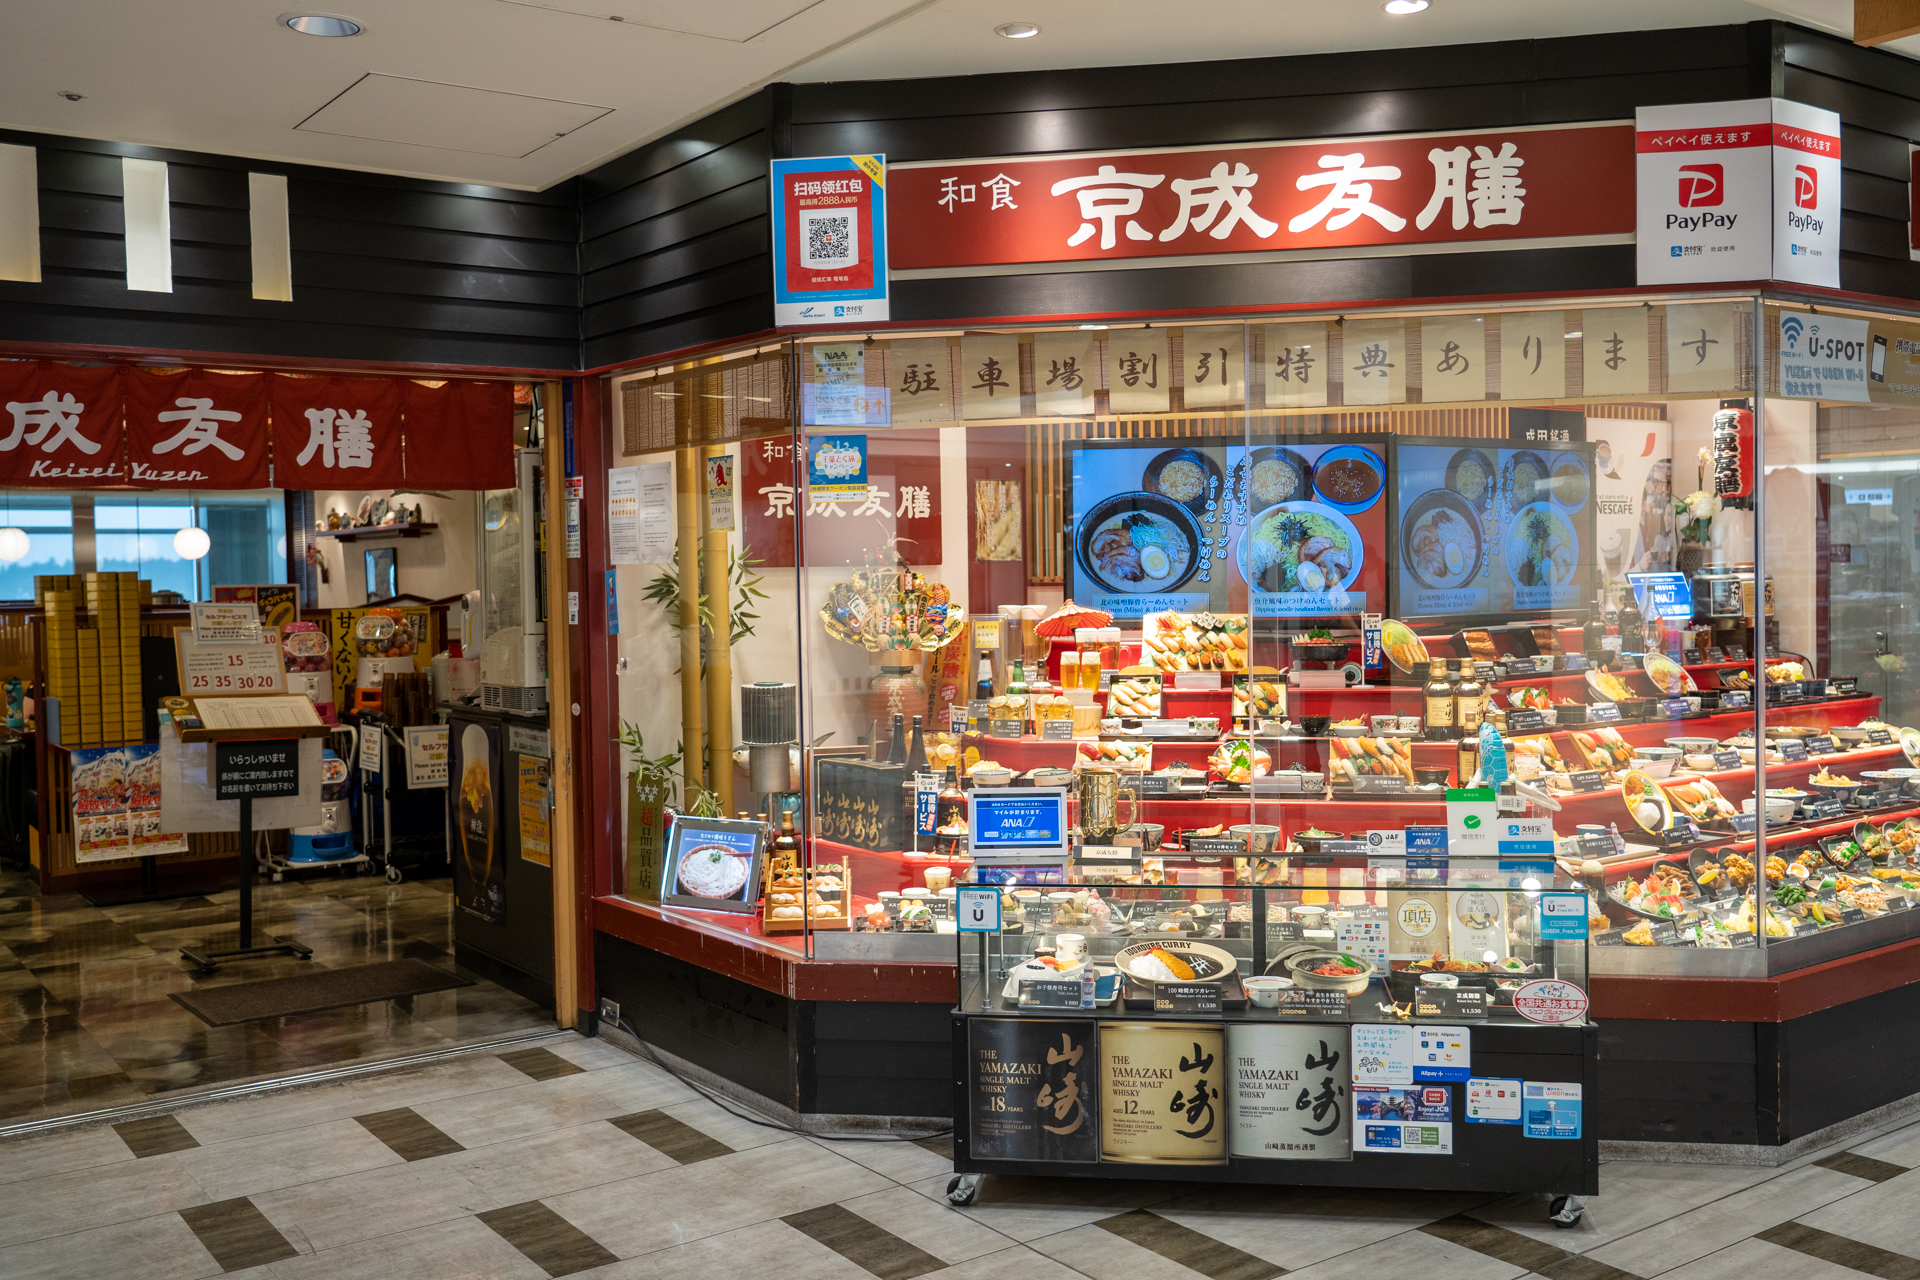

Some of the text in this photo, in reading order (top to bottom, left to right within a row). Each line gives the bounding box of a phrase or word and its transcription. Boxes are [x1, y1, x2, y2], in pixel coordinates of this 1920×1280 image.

[1651, 131, 1752, 146] ペイペイ使えます
[1781, 132, 1831, 152] ペイペイ使えます
[794, 179, 863, 196] 扫码领红包
[938, 173, 1021, 213] 和食
[800, 196, 858, 206] 最高得2888人民币
[1050, 141, 1528, 250] 京成友膳
[1666, 212, 1738, 232] PayPay
[1788, 211, 1824, 235] PayPay
[1809, 336, 1864, 362] U-SPOT
[899, 329, 1719, 397] 駐車場割引特典あります
[1784, 365, 1844, 380] YUZEN で USEN
[822, 376, 851, 388] SAMPLE
[30, 460, 208, 481] Keisei Yuzen
[1216, 465, 1235, 559] こだわりスープの
[1198, 476, 1218, 582] らーめん・つけめん
[258, 591, 294, 607] チョコバナナ
[264, 635, 276, 645] 10
[1374, 632, 1381, 649] 優待
[336, 610, 356, 690] 甘くない!
[1366, 632, 1374, 665] サービス
[228, 655, 244, 667] 15
[192, 675, 274, 689] 25 35 30 20
[230, 753, 286, 765] いらっしゃいませ
[222, 770, 294, 781] 係が順にご案内致しますので
[222, 782, 294, 794] お名前を書いてお待ち下さい
[77, 798, 121, 813] 解放せよ
[928, 794, 936, 813] 優待
[822, 790, 836, 837] 山崎
[836, 792, 851, 841] 山崎
[851, 796, 867, 843] 山崎
[920, 794, 928, 831] サービス
[866, 798, 882, 847] 山崎
[1000, 818, 1023, 827] ANA
[1520, 824, 1542, 833] 支付宝
[639, 806, 654, 889] 超品質店
[1403, 910, 1431, 924] 頂店
[1125, 941, 1192, 957] 100HOURS CURRY
[1518, 998, 1586, 1010] 全国共通お食事券
[980, 1050, 997, 1059] THE
[1112, 1056, 1130, 1065] THE
[1238, 1058, 1256, 1066] THE
[980, 1062, 1042, 1075] YAMAZAKI
[1112, 1068, 1173, 1079] YAMAZAKI
[1238, 1070, 1299, 1081] YAMAZAKI
[980, 1076, 1031, 1084] SINGLE MALT
[1036, 1032, 1084, 1136] 山崎
[1112, 1080, 1164, 1089] SINGLE MALT
[1238, 1082, 1290, 1090] SINGLE MALT
[980, 1085, 1007, 1093] WHISKY
[1112, 1089, 1140, 1097] WHISKY
[1170, 1042, 1219, 1139] 山崎
[1239, 1091, 1266, 1099] WHISKY
[1295, 1040, 1344, 1136] 山崎
[990, 1096, 1006, 1112] 18
[1124, 1100, 1139, 1115] 12
